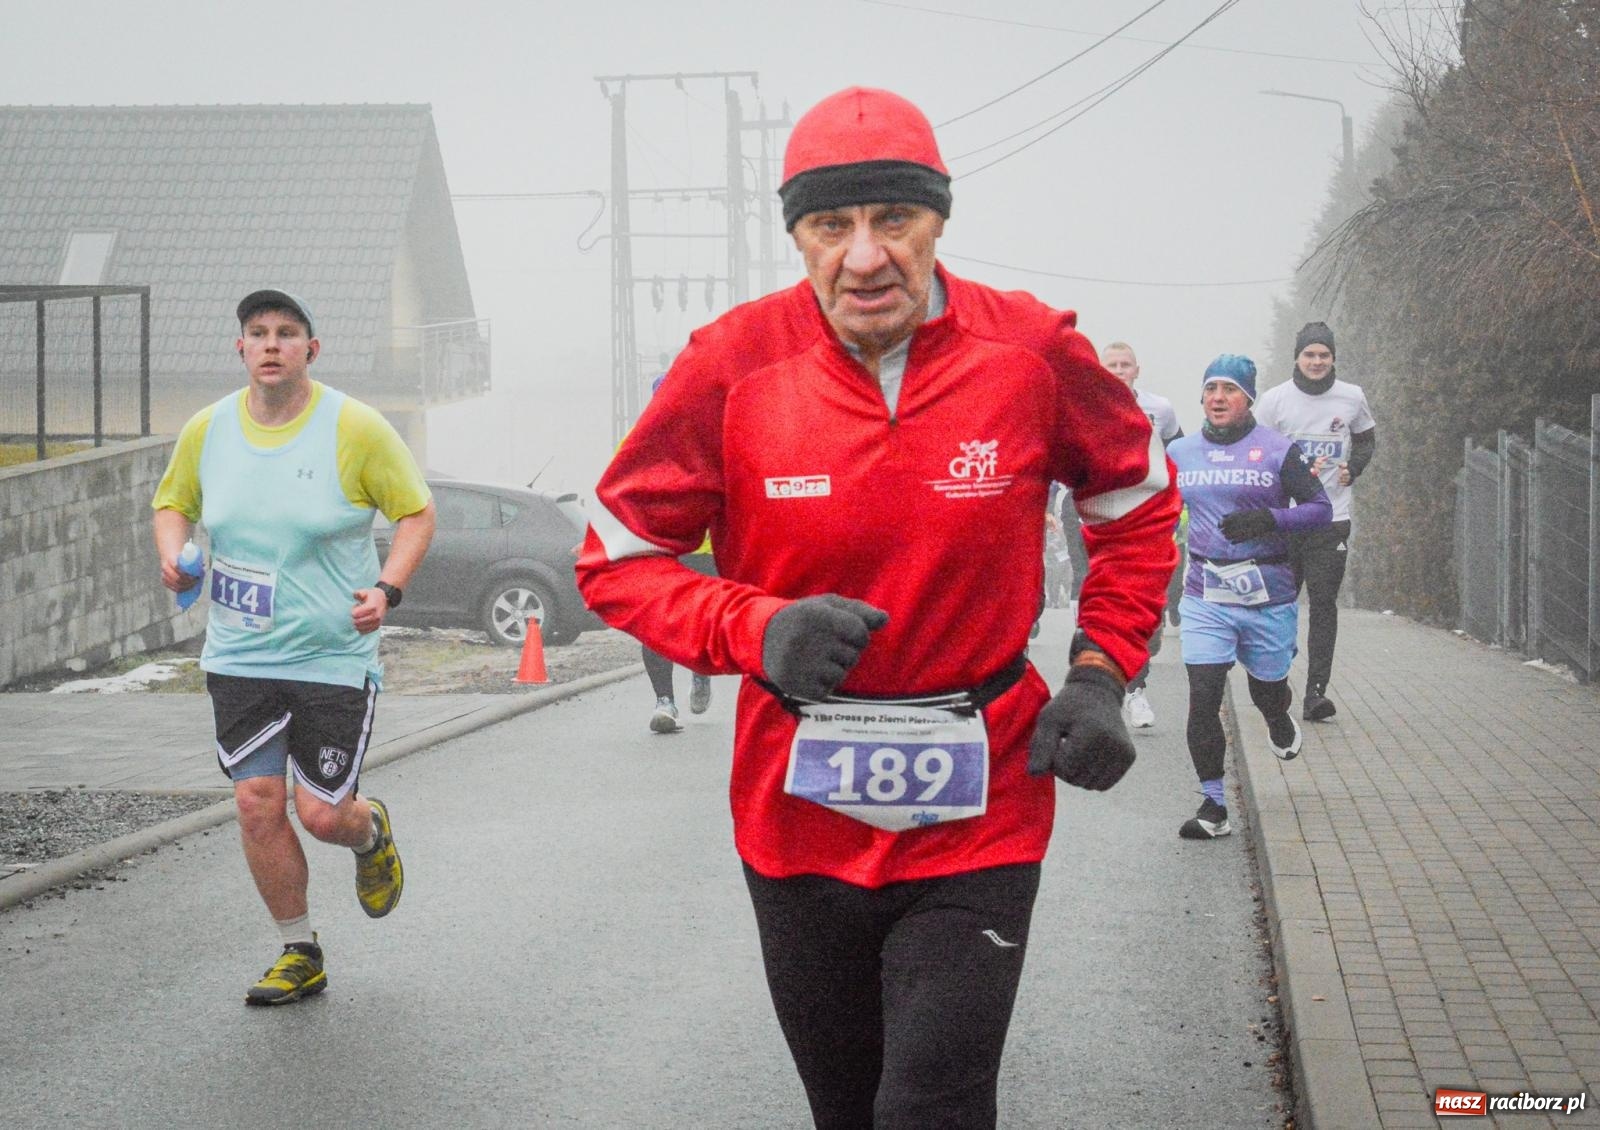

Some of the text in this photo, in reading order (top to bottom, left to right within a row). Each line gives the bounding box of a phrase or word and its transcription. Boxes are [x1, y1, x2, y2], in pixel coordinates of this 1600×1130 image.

[1303, 441, 1336, 457] 160
[1177, 469, 1274, 487] RUNNERS
[218, 576, 260, 613] 114
[834, 713, 862, 723] Cross
[864, 715, 877, 724] po
[878, 714, 907, 723] Ziemi
[320, 748, 346, 766] NETS
[827, 746, 954, 802] 189
